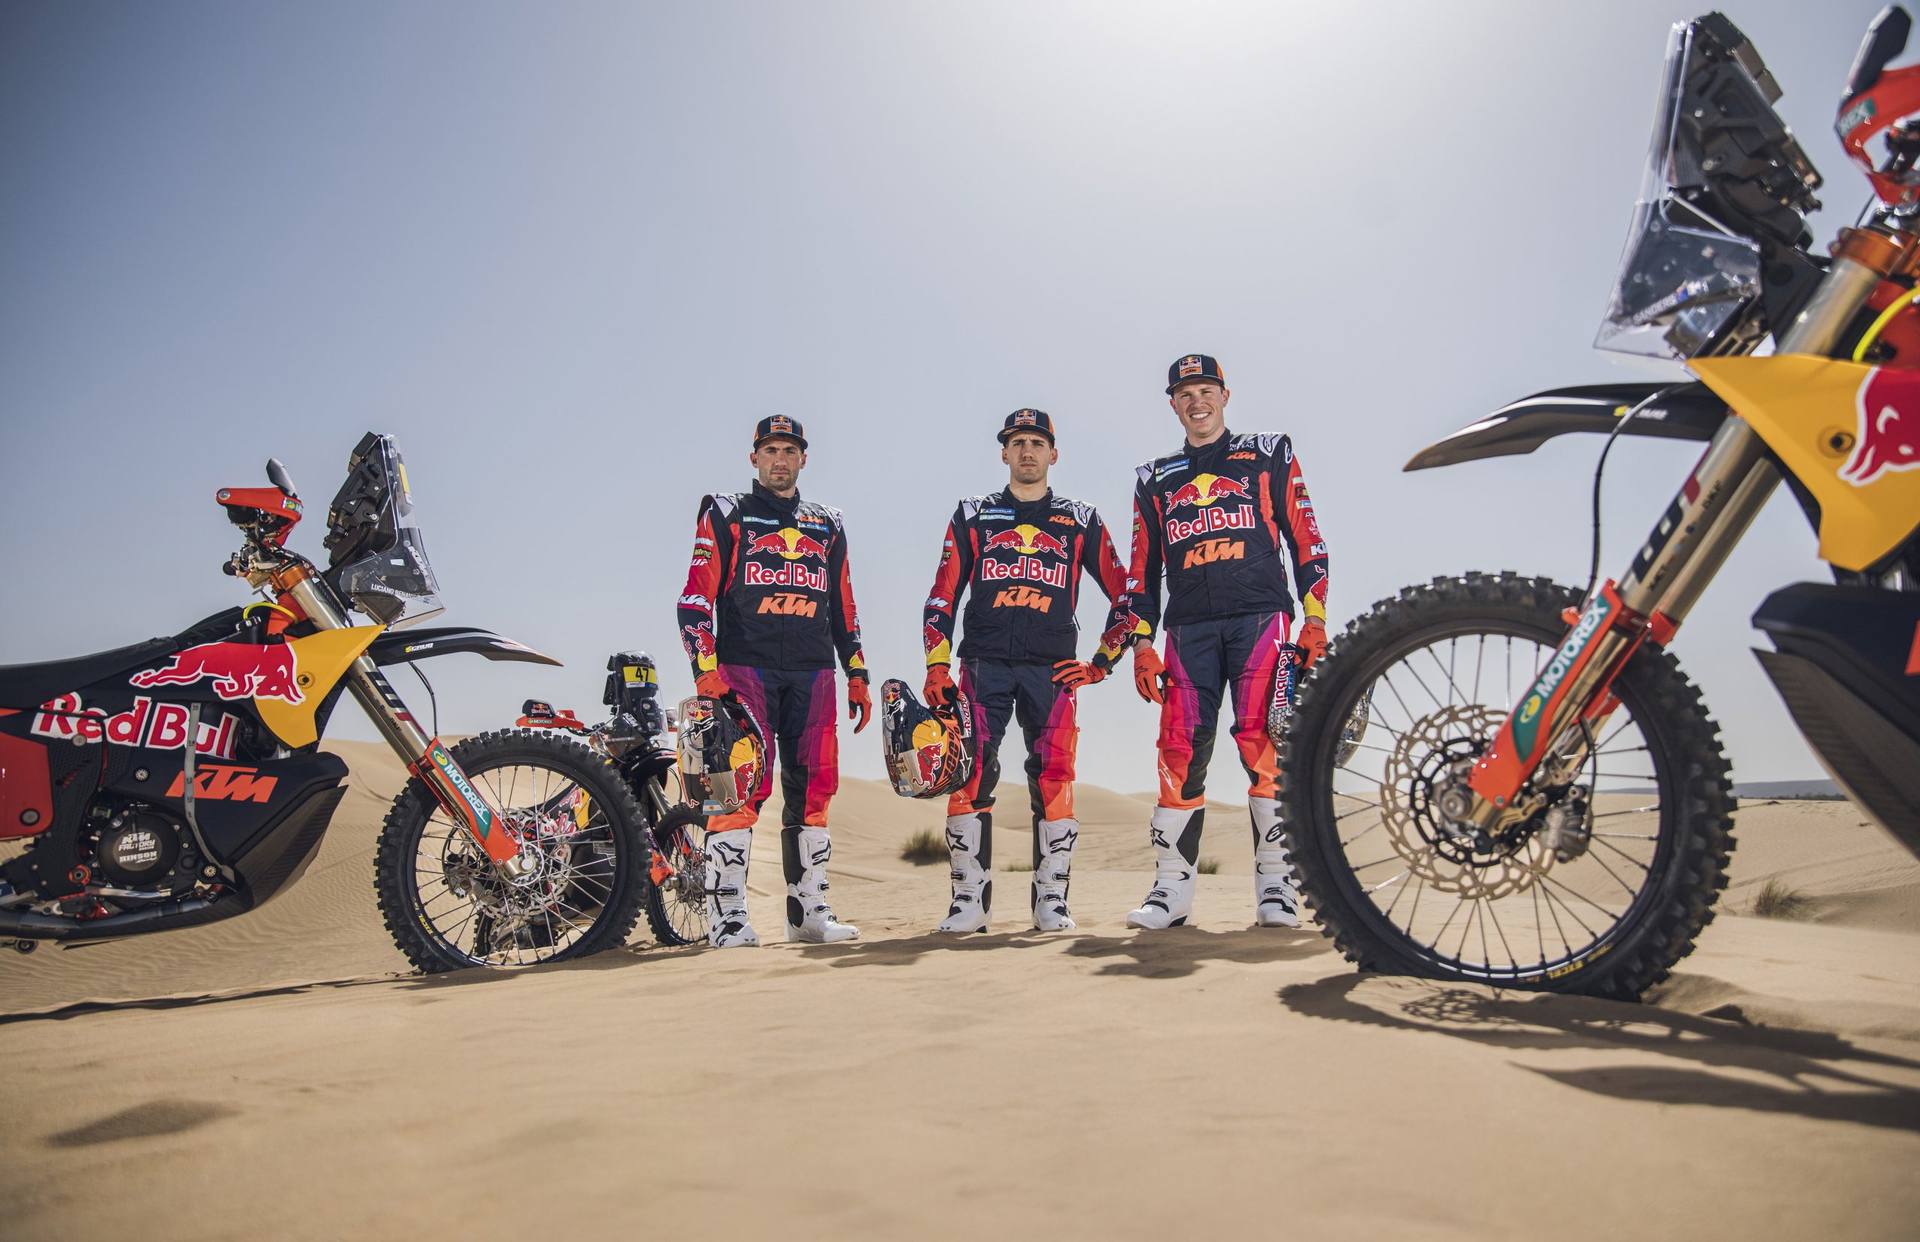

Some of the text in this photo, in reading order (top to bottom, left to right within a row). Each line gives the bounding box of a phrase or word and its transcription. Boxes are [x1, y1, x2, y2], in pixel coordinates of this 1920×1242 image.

[1049, 514, 1075, 527] KTM
[1166, 508, 1208, 545] Red
[1208, 504, 1255, 531] Bull
[1183, 537, 1245, 570] KTM
[745, 561, 828, 592] Red Bull
[982, 556, 1068, 588] Red Bull
[371, 583, 395, 595] LUCIANO
[992, 585, 1053, 613] KTM
[757, 592, 817, 618] KTM
[1536, 604, 1608, 697] MOTOREX
[635, 667, 649, 682] 47
[1274, 650, 1295, 708] Red Bull
[31, 691, 238, 761] Red Bull
[165, 764, 278, 803] KTM
[444, 763, 489, 818] MOTOREX
[118, 839, 155, 852] FACTORY
[1547, 960, 1584, 979] EXCEL
